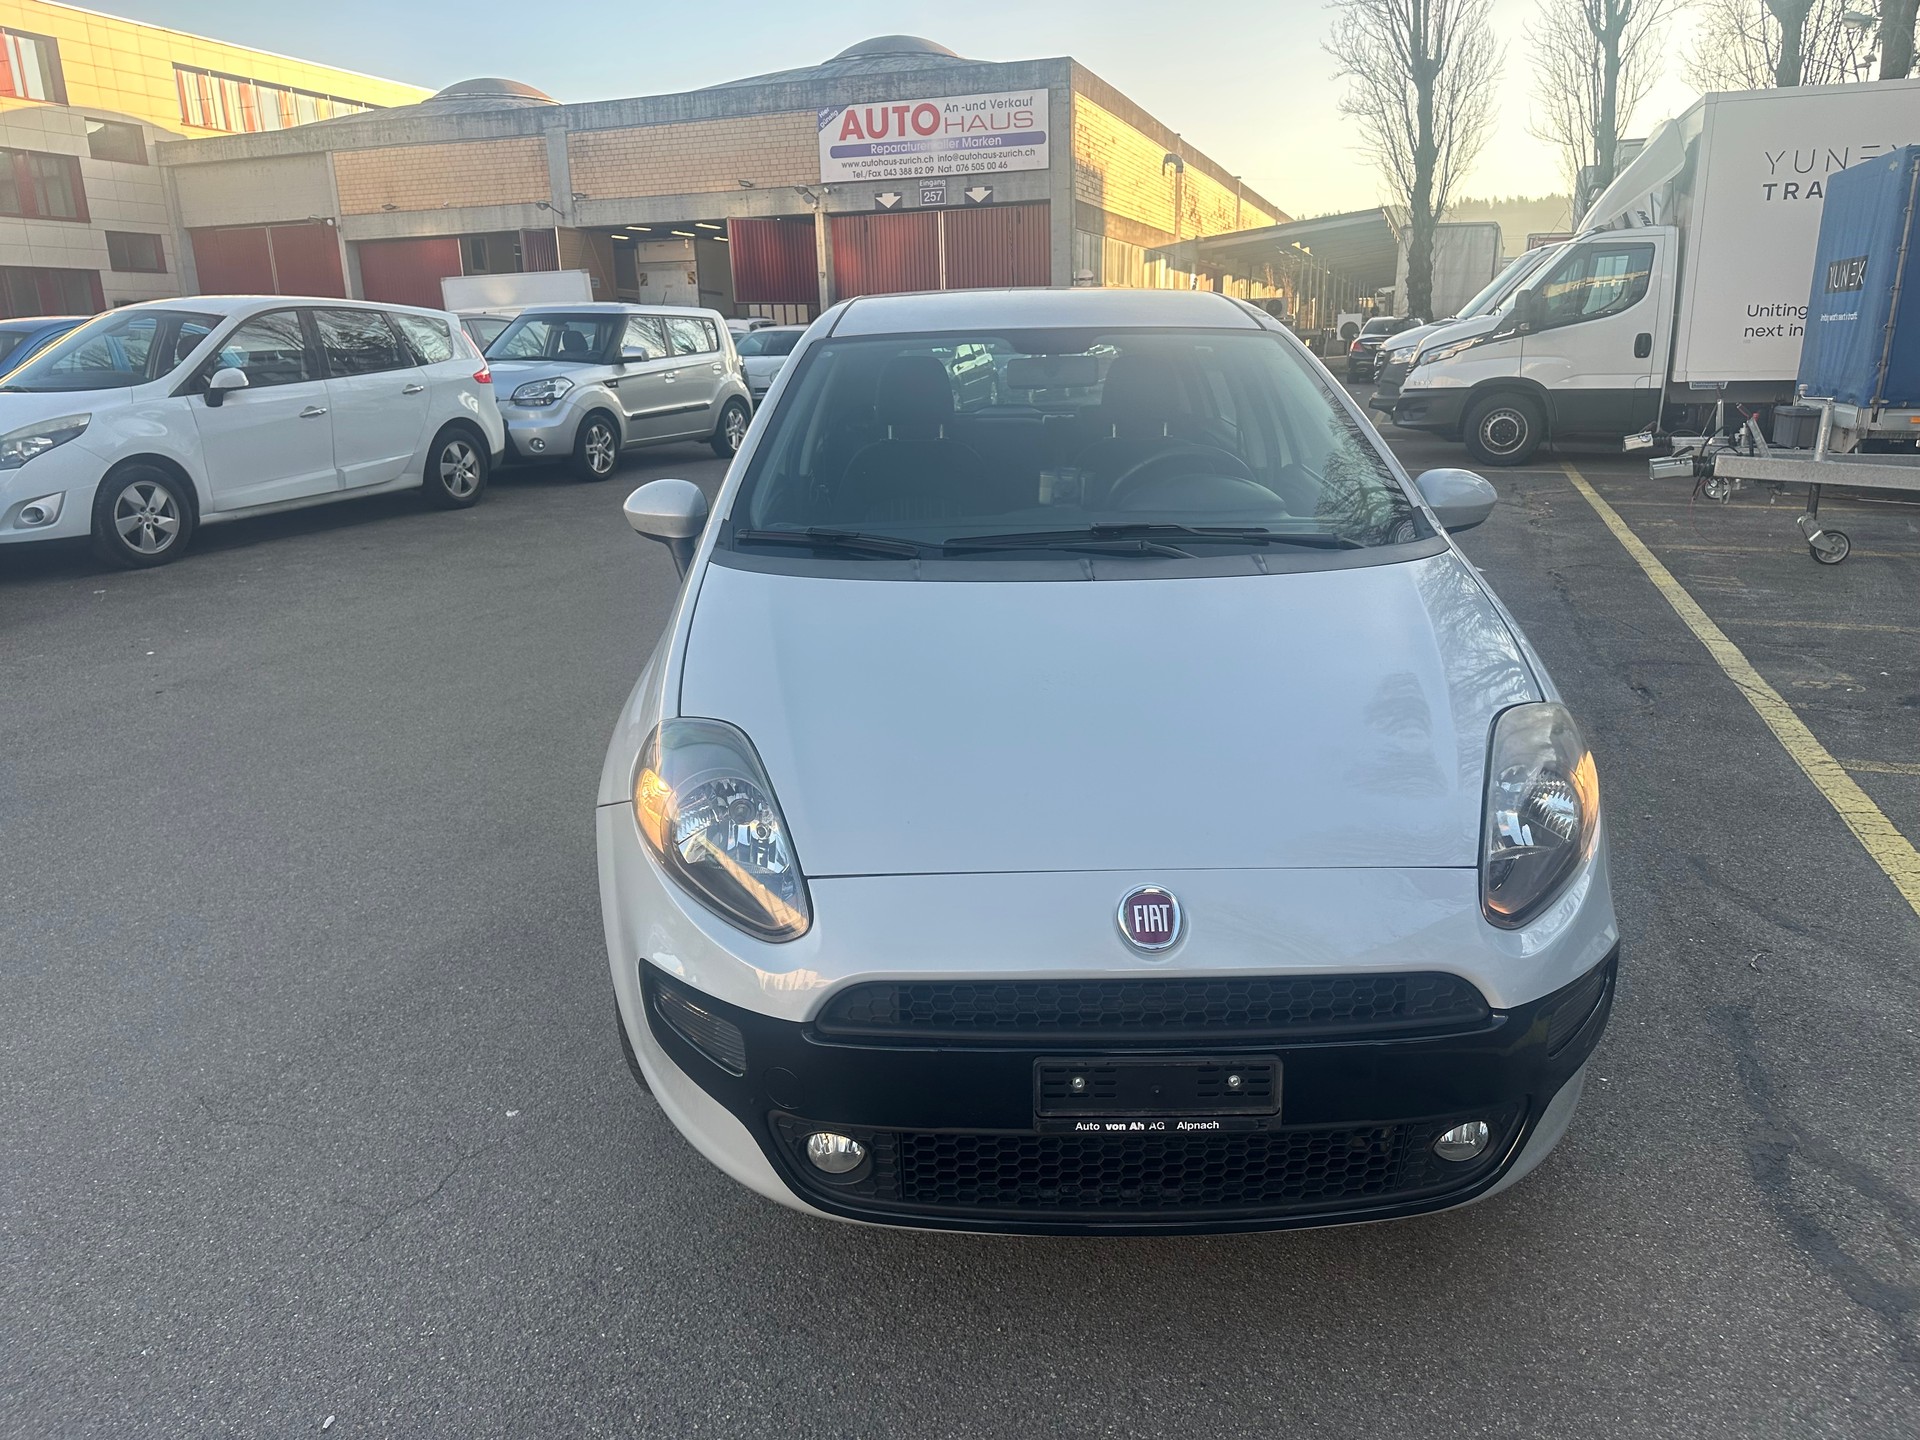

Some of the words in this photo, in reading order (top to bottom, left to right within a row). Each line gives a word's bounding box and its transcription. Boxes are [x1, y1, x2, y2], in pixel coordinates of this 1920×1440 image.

[944, 103, 959, 113] An
[989, 96, 1033, 109] Verkauf
[839, 103, 941, 141] AUTO
[944, 110, 1034, 134] HAUS
[961, 136, 1002, 148] Marken
[841, 155, 934, 168] www.autohaus-zurich.ch
[937, 148, 1036, 162] info@autohaus-zurich.ch
[852, 169, 882, 179] Tel./Fax
[883, 168, 897, 177] 043
[899, 167, 912, 176] 388
[914, 167, 924, 175] 82
[925, 166, 934, 174] 09
[955, 163, 970, 172] 076
[971, 162, 985, 171] 505
[986, 161, 997, 170] 00
[998, 161, 1008, 169] 46
[919, 179, 946, 187] Eingang
[923, 190, 943, 202] 257
[1829, 261, 1866, 288] YUNEX
[1747, 303, 1808, 319] Uniting
[1744, 324, 1784, 337] next
[1789, 323, 1804, 337] in
[1133, 904, 1170, 933] FIAT
[1075, 1122, 1100, 1131] Auto
[1105, 1123, 1126, 1131] von
[1129, 1122, 1145, 1131] Ah
[1149, 1121, 1165, 1130] AG
[1177, 1121, 1220, 1131] Alpnach
